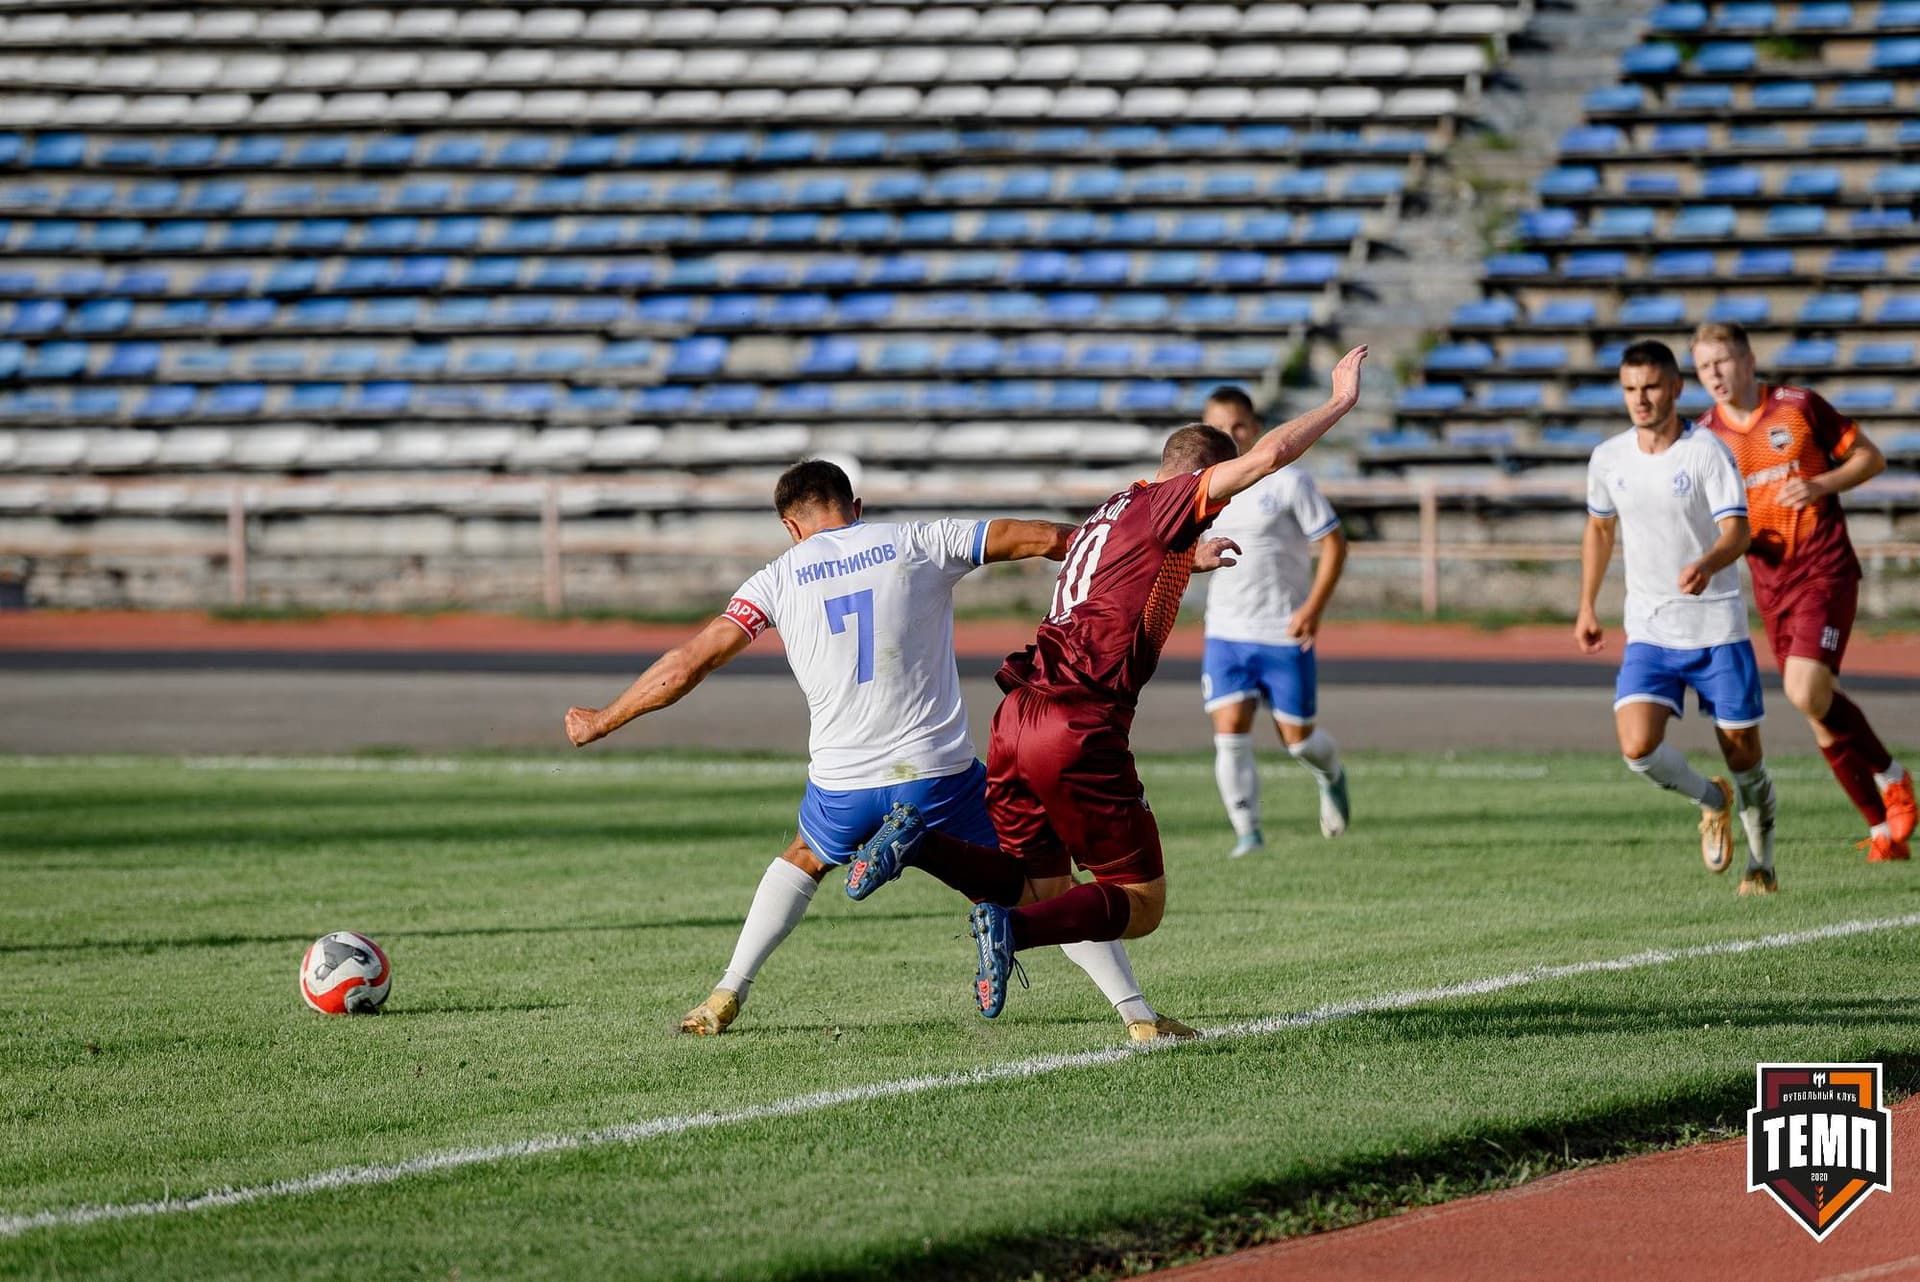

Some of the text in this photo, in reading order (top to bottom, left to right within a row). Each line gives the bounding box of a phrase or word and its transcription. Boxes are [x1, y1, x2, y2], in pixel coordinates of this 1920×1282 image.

[795, 543, 897, 587] ЖИТНИКОВ
[1048, 523, 1112, 620] 10
[823, 588, 874, 685] 7
